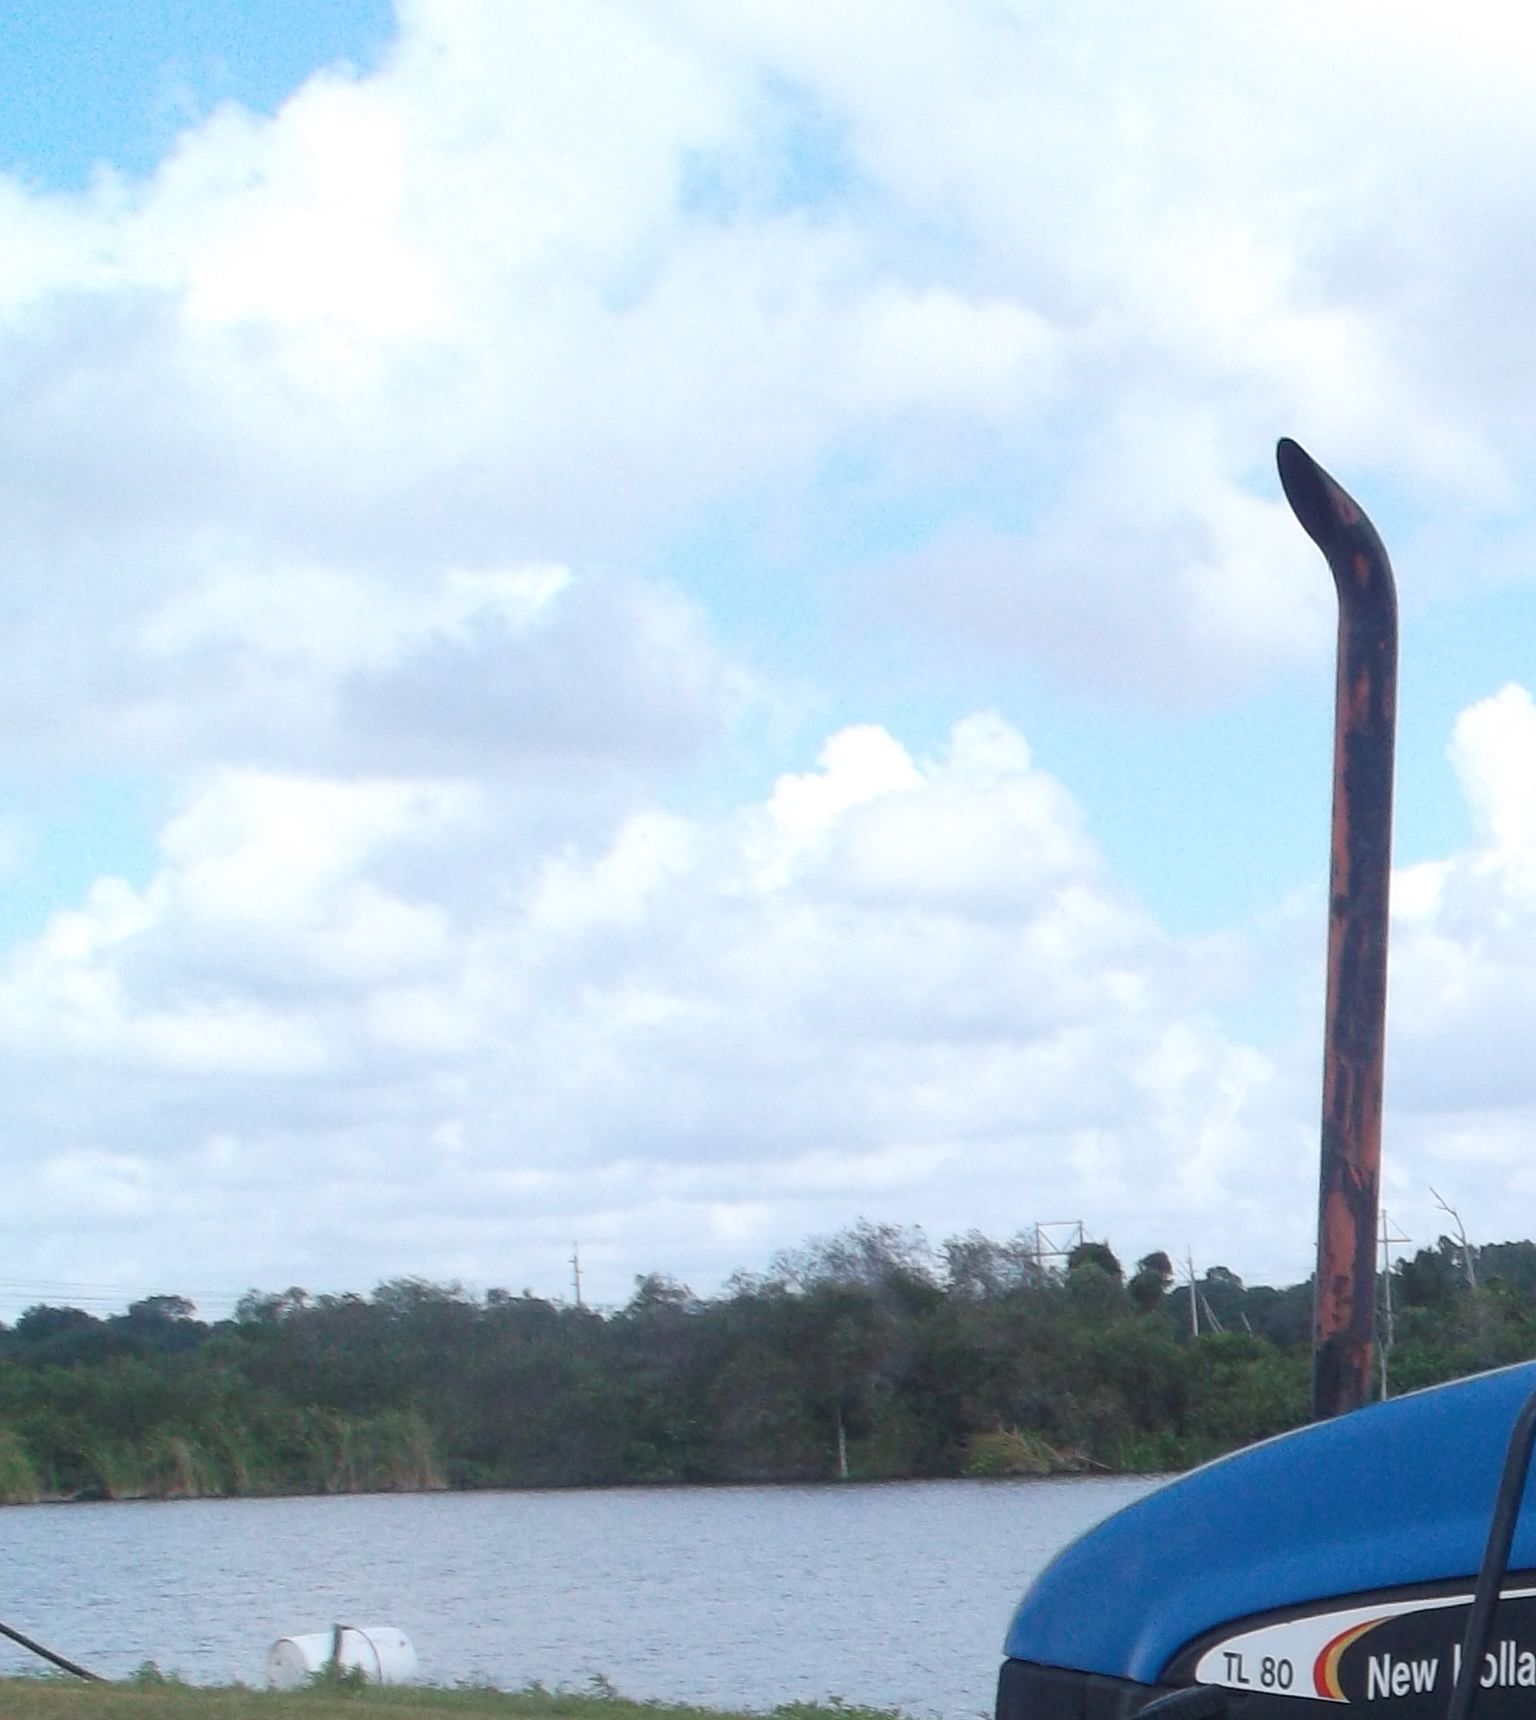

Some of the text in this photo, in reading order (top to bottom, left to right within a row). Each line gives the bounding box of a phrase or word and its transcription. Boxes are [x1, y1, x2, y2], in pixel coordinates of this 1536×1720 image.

[1223, 1651, 1294, 1690] TL 80
[1367, 1653, 1439, 1700] New
